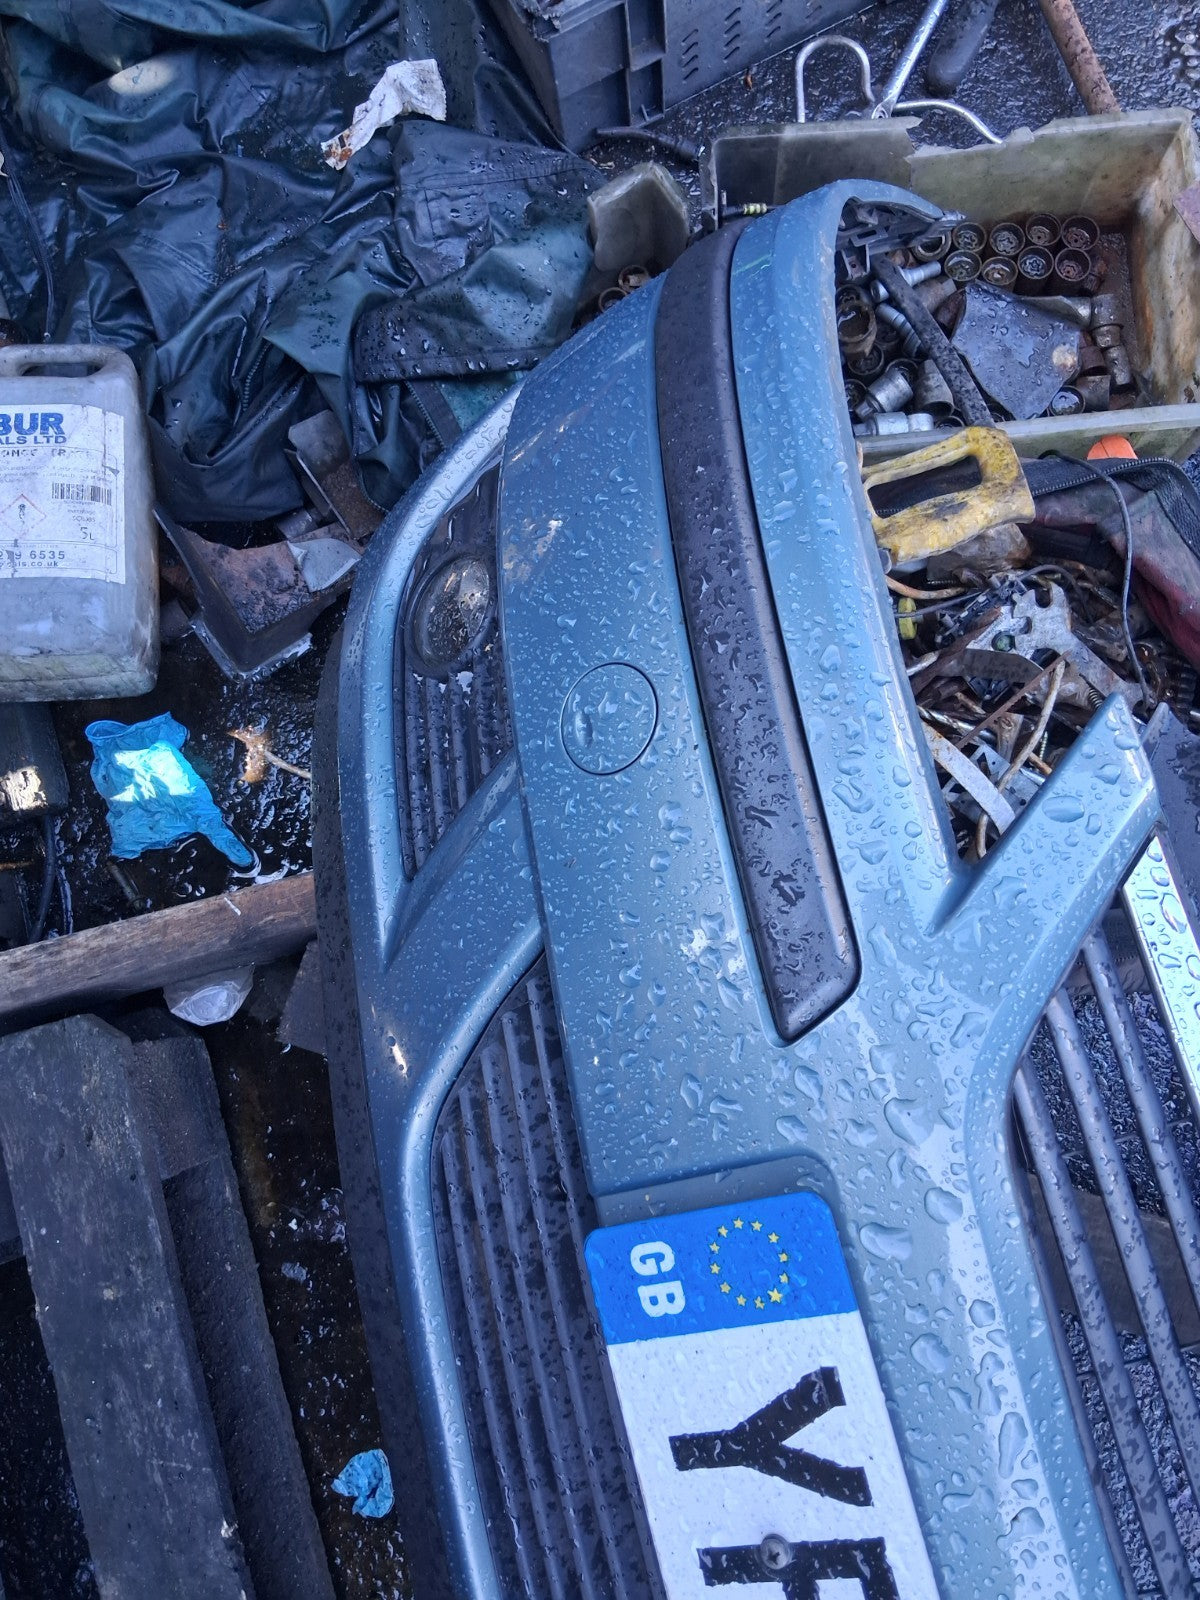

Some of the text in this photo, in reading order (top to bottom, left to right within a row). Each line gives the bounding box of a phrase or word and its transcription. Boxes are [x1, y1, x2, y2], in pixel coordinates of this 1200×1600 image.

[33, 435, 67, 445] LTD
[29, 550, 65, 560] 6535
[630, 1240, 686, 1318] GB
